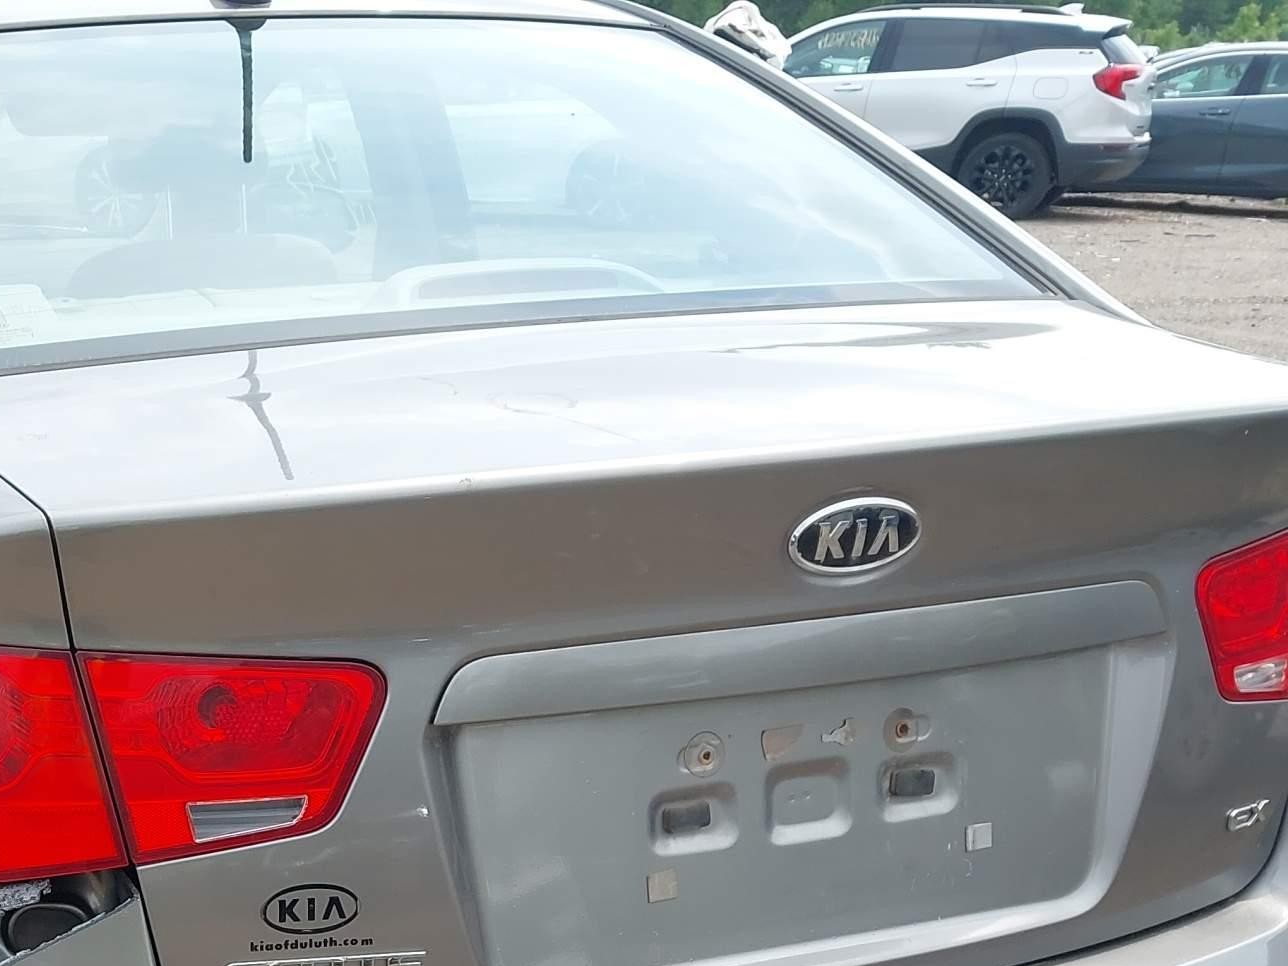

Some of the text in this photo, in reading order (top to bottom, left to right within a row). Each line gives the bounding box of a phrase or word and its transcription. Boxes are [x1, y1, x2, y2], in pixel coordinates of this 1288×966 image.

[814, 515, 900, 563] KIA
[278, 896, 347, 923] KIA
[250, 936, 374, 953] kiaofduluth.com
